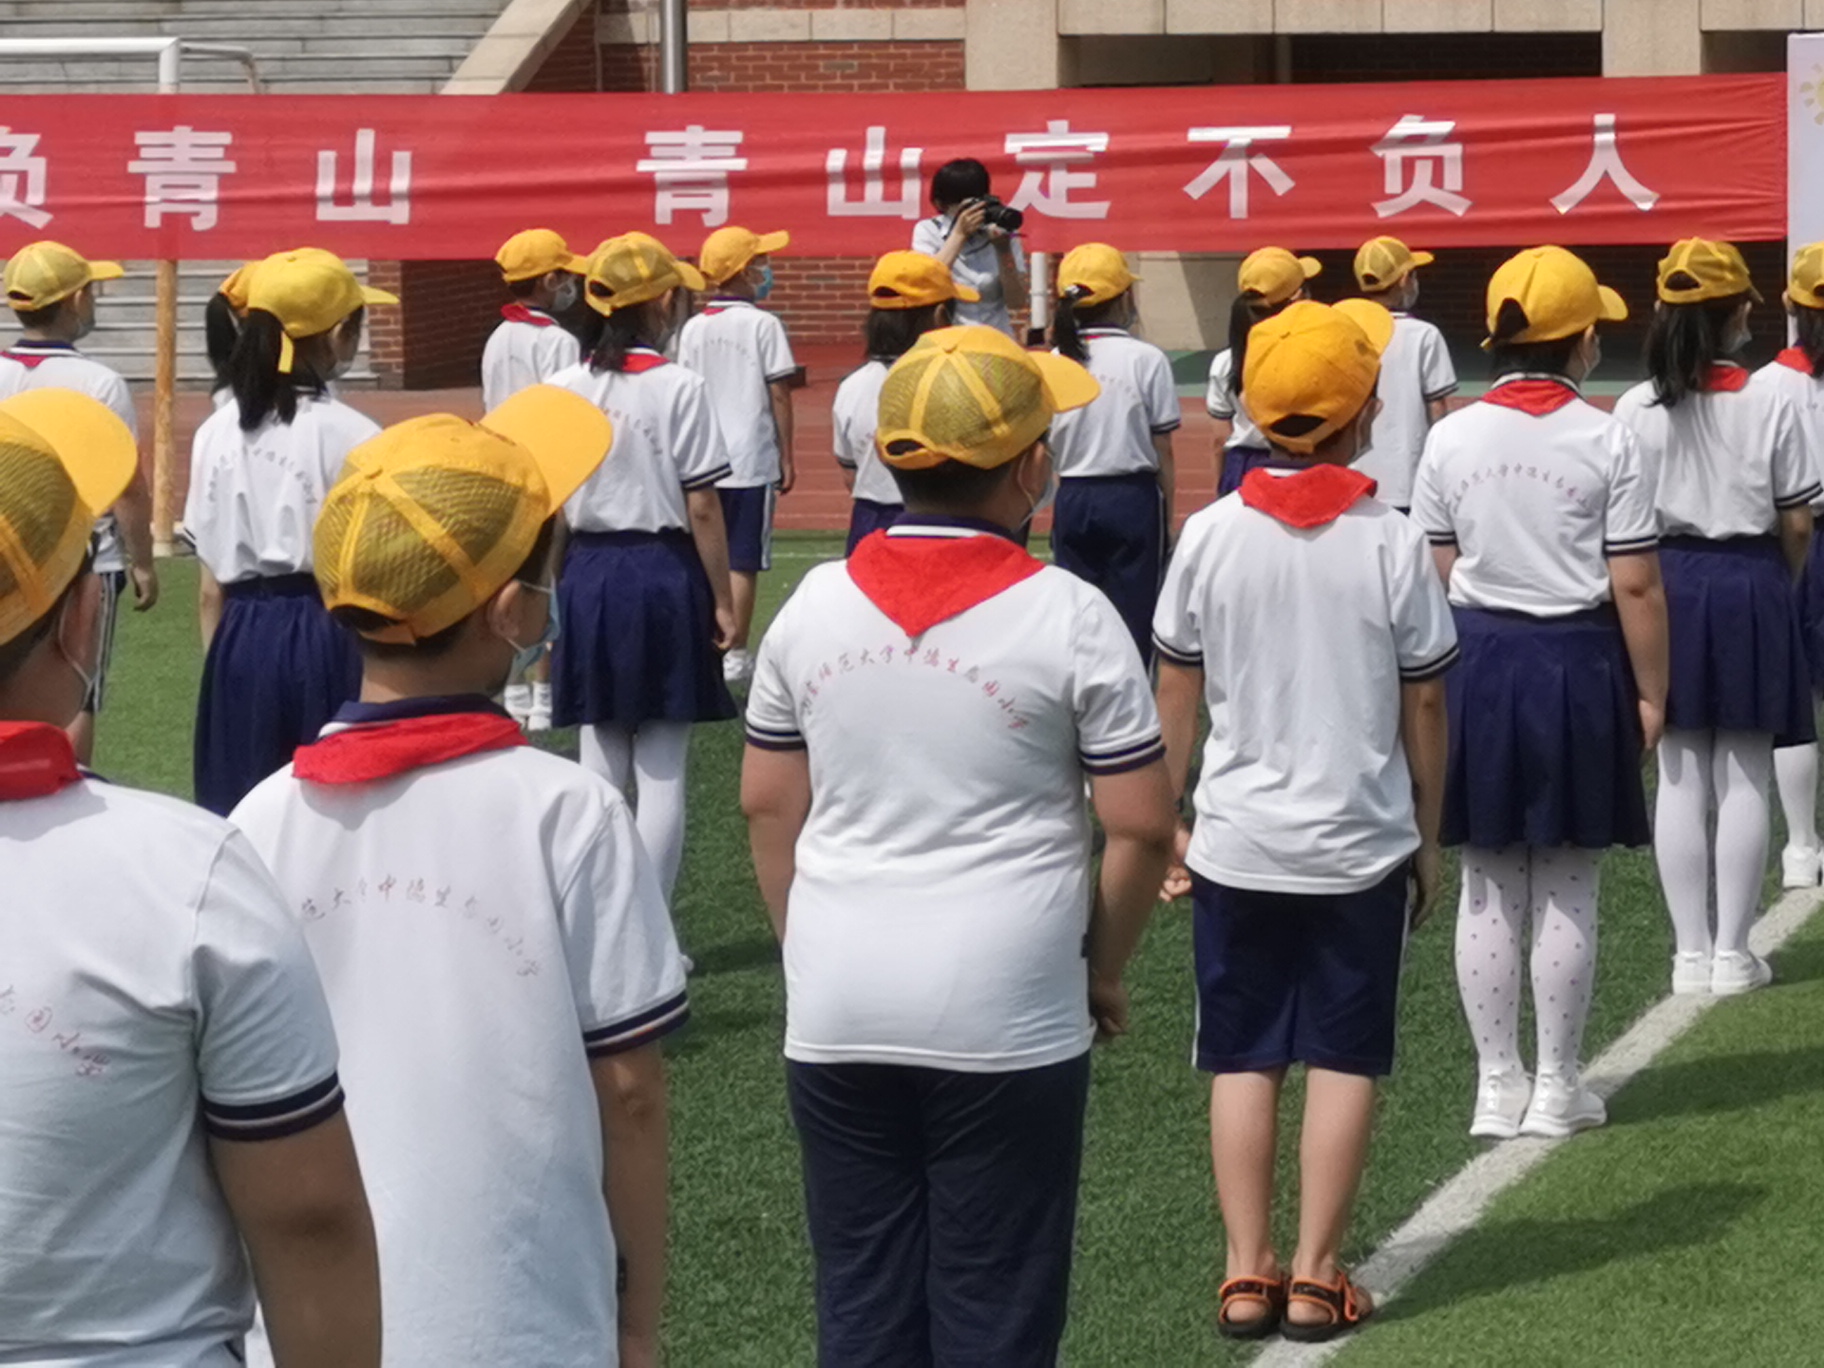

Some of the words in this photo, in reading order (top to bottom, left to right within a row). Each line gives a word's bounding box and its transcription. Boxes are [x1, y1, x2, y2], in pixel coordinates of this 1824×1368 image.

[636, 113, 1660, 227] 青山定不负人
